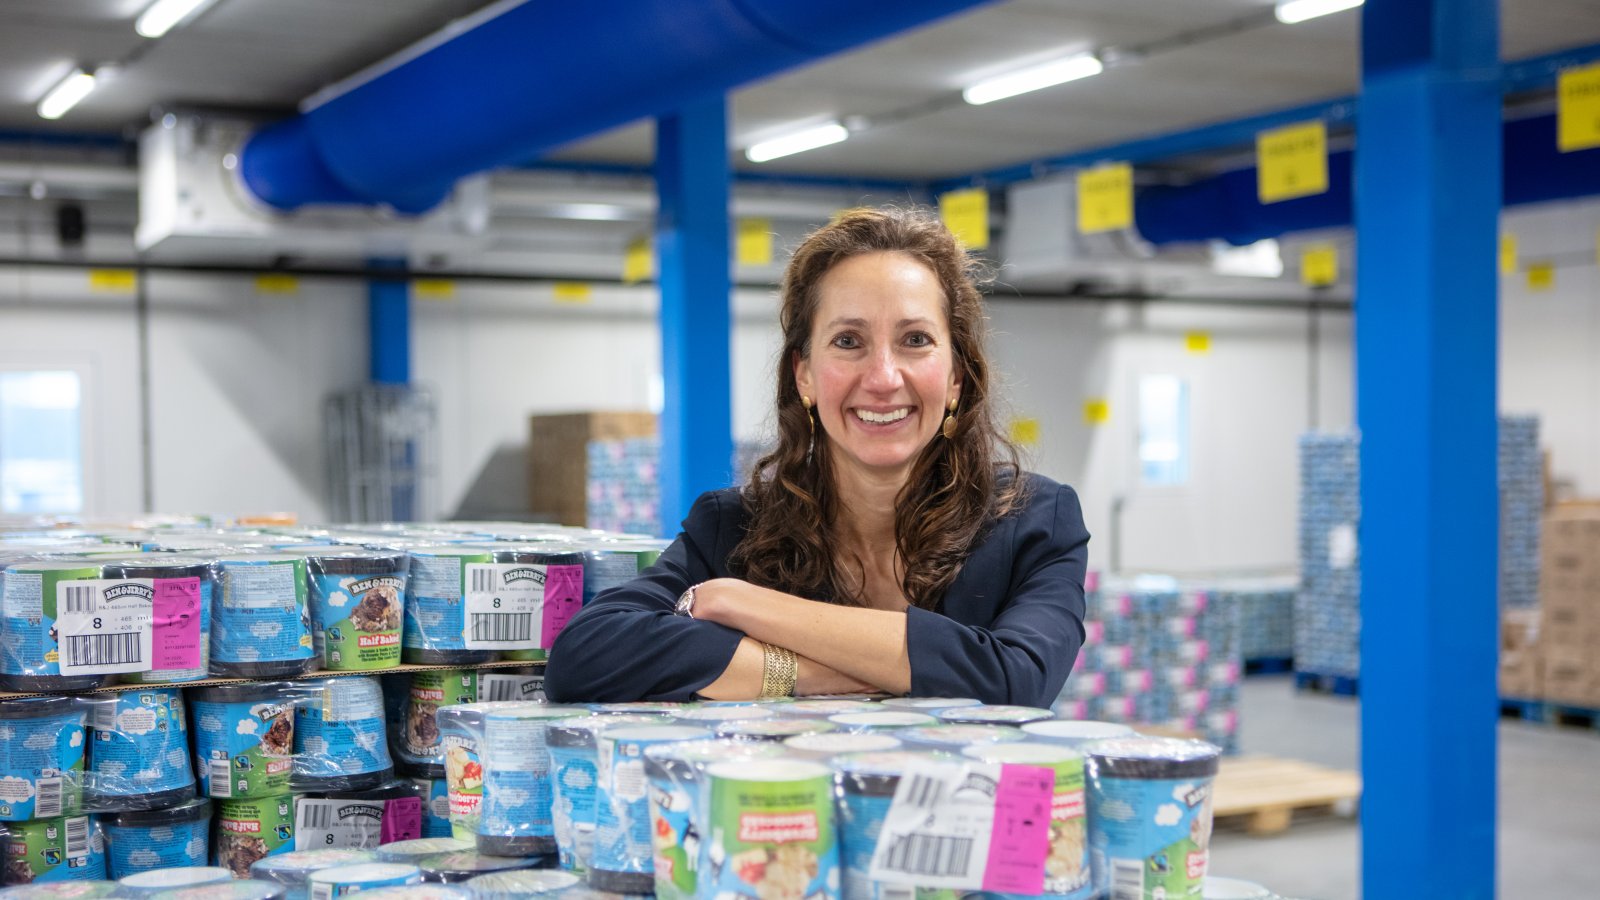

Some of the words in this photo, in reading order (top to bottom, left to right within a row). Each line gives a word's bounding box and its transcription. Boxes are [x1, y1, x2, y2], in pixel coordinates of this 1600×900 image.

[493, 597, 501, 608] 8
[93, 617, 102, 629] 8
[359, 635, 379, 646] Half
[325, 833, 334, 844] 8
